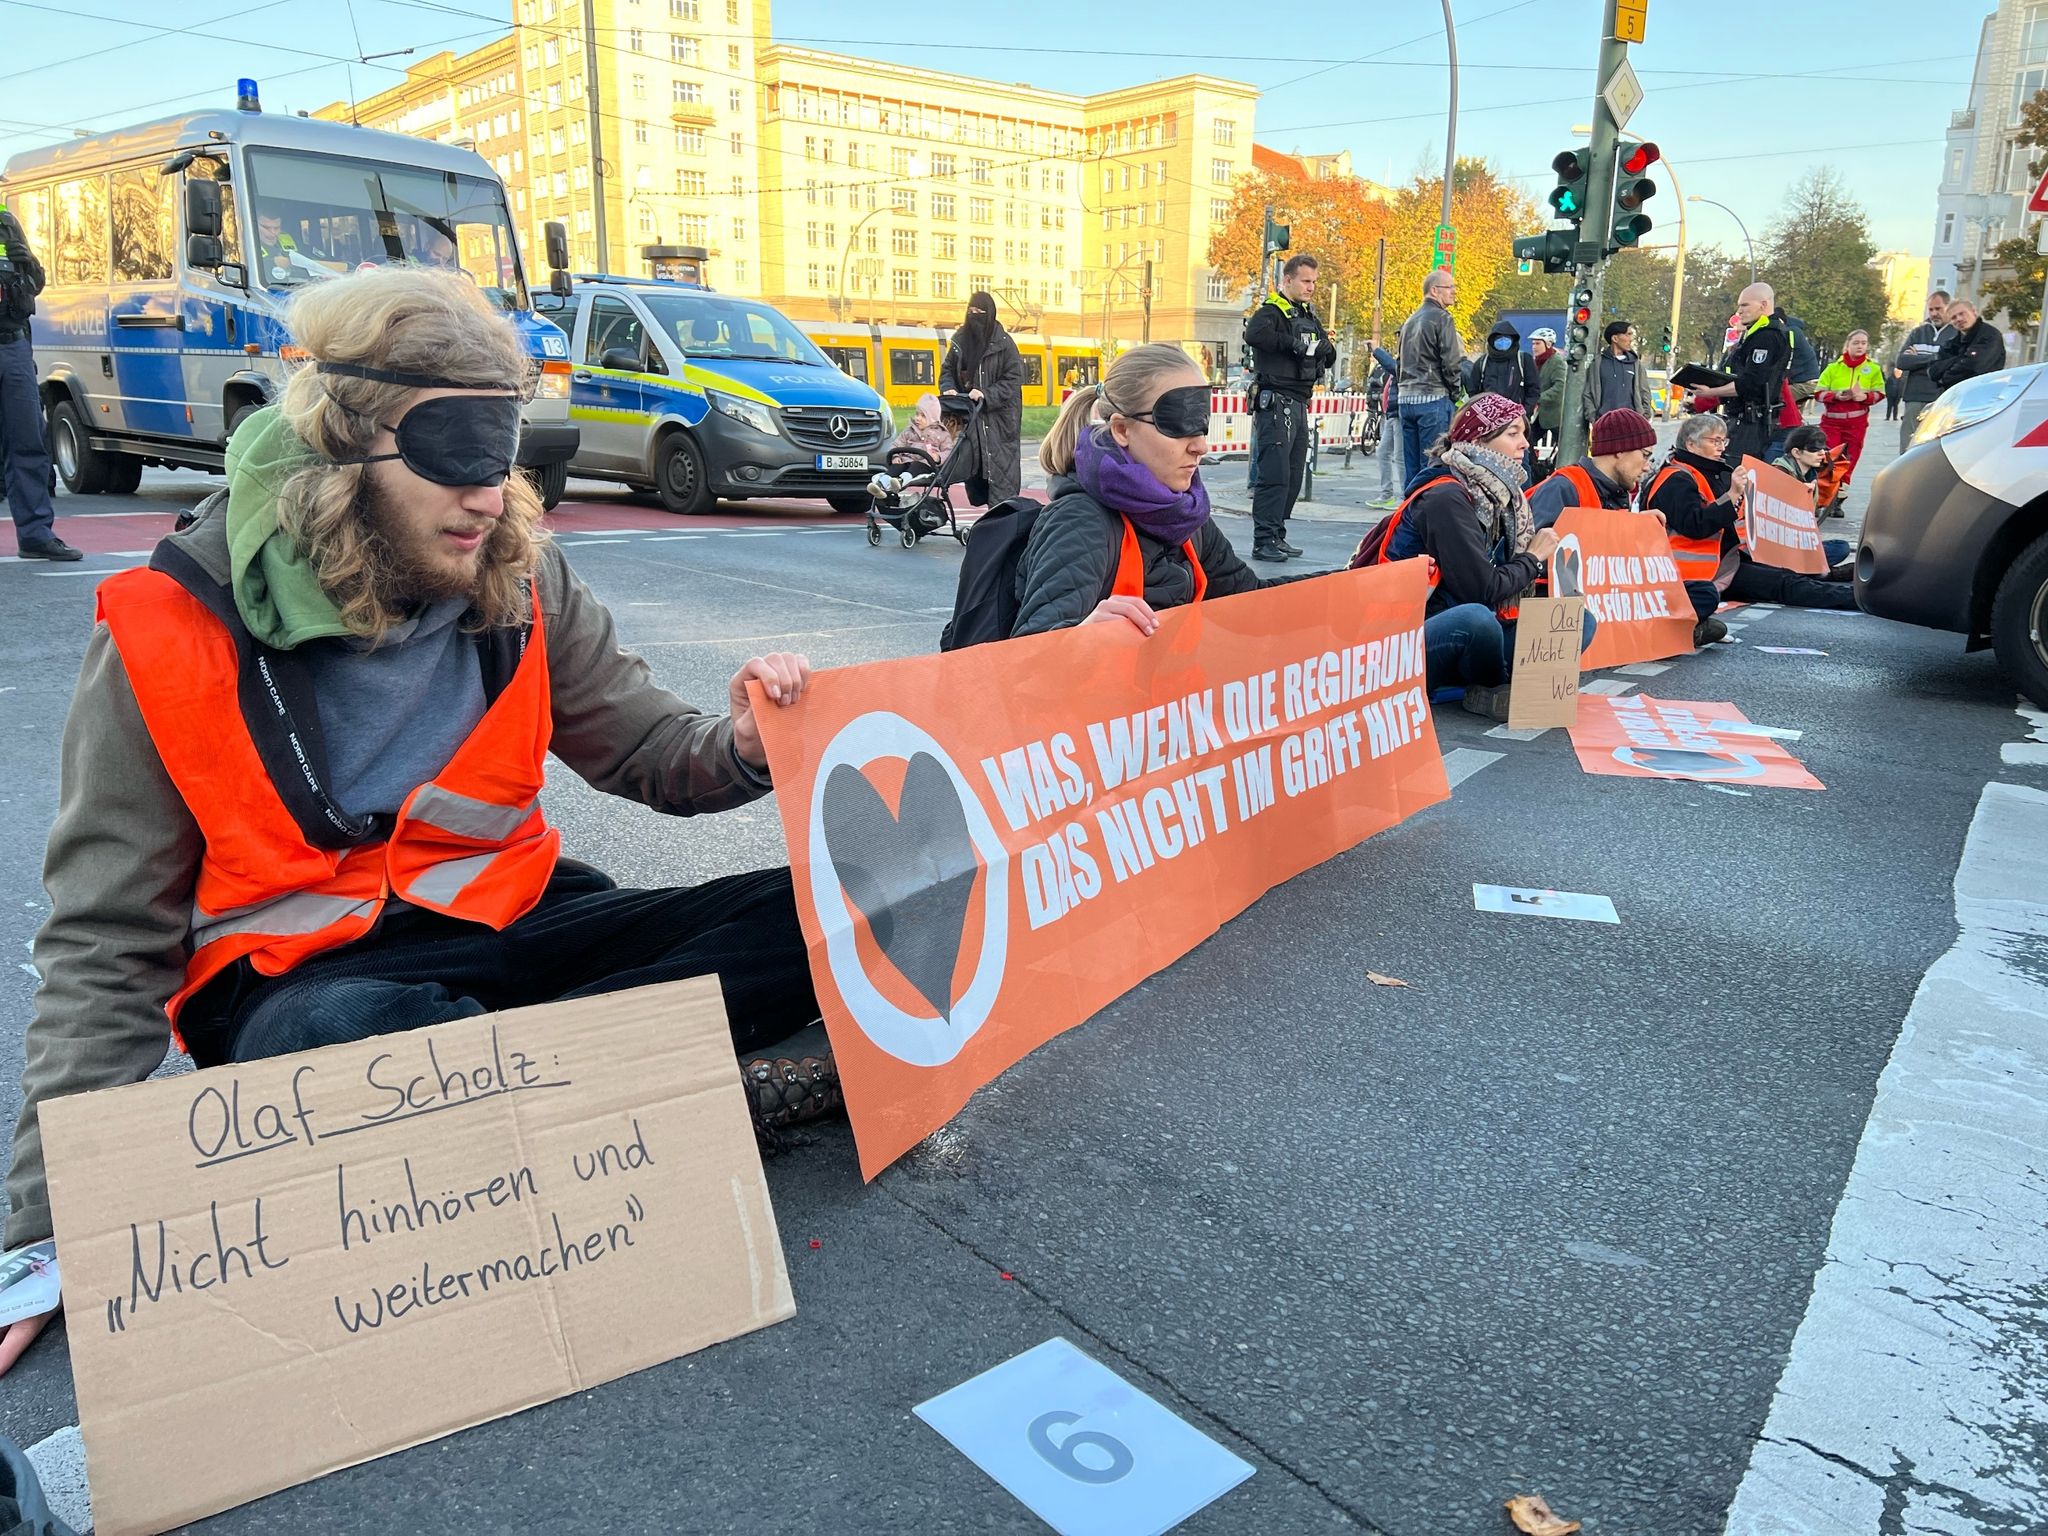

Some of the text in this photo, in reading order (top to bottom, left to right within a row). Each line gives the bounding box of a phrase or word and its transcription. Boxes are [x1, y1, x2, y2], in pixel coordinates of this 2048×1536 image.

[1627, 15, 1635, 35] 5
[62, 307, 107, 336] POLIZEI
[545, 338, 564, 355] 13
[826, 456, 864, 468] B 30864
[1586, 555, 1606, 587] 100
[1643, 555, 1678, 584] UND
[1603, 587, 1632, 622] FÜR
[1632, 589, 1671, 621] ALLE
[257, 655, 286, 717] NORD CAPE
[288, 732, 319, 794] NORD CAPE
[980, 732, 1095, 832] WAS,
[1086, 688, 1225, 791] WENN
[1222, 669, 1280, 743] DIE
[1021, 686, 1427, 931] DAS NICHT IM GRIFF HAT?
[189, 1024, 560, 1158] Olaf Scholz:
[338, 1158, 539, 1250] hinhören
[573, 1118, 655, 1181] und
[1028, 1410, 1134, 1484] 6
